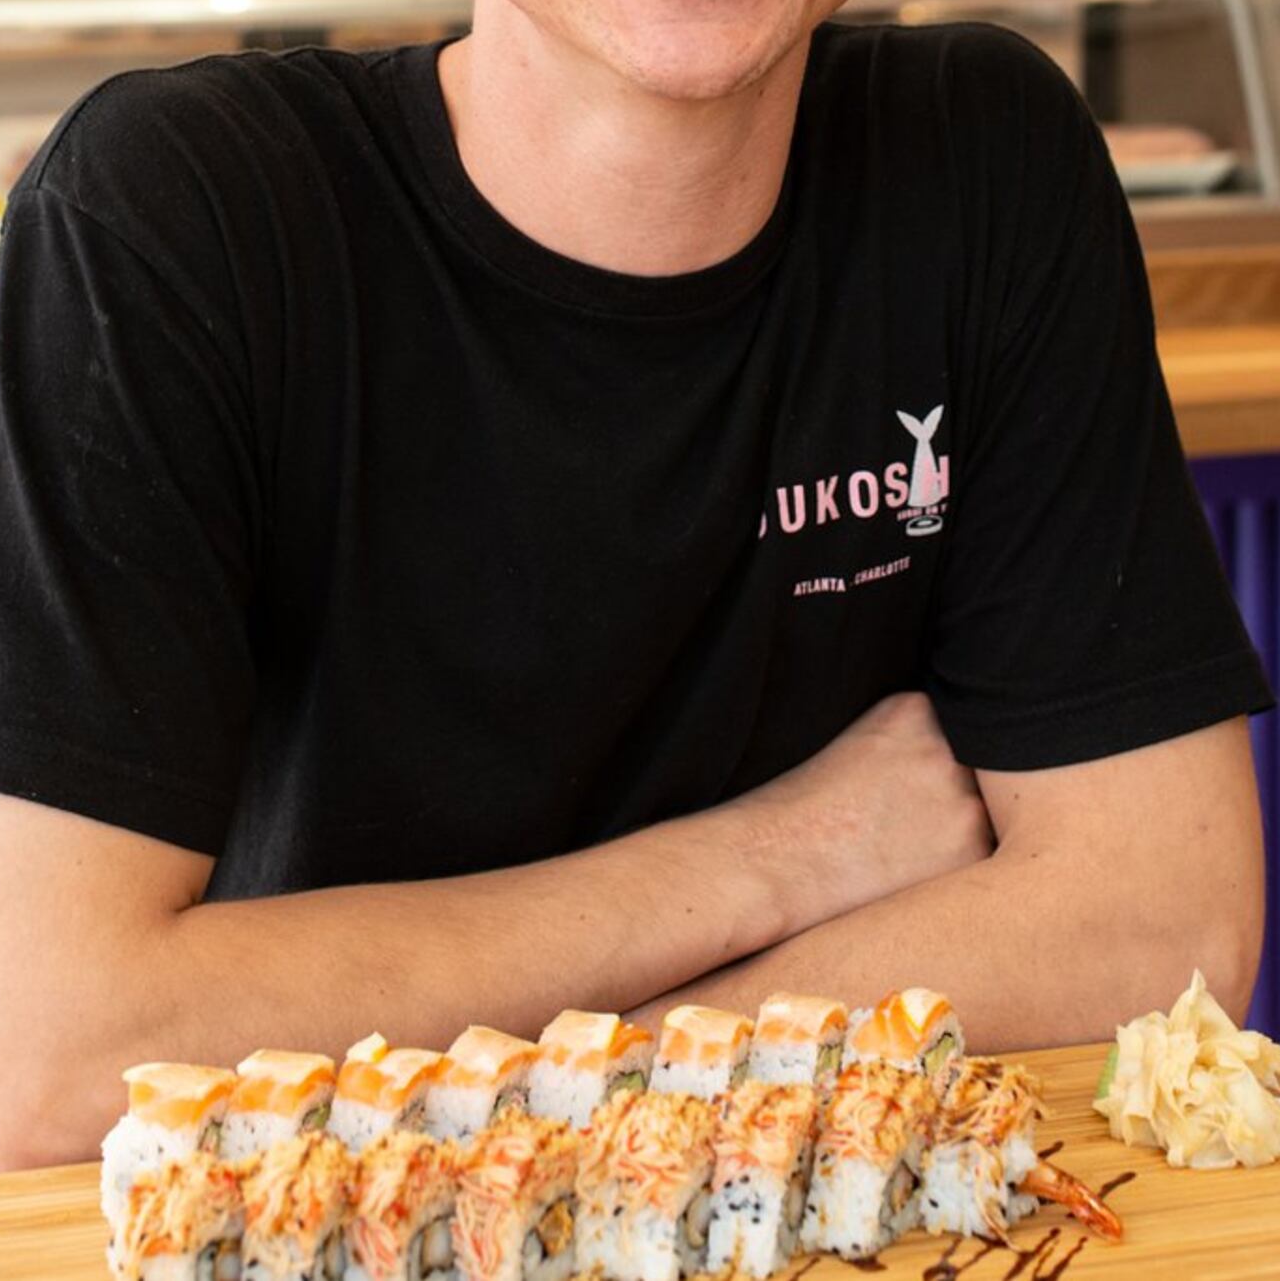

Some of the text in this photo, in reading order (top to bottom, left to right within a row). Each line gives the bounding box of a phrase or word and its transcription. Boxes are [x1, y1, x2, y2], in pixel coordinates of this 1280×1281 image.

[758, 454, 951, 539] UKOSH
[793, 556, 911, 596] ATLANTA CHARLOTTE
